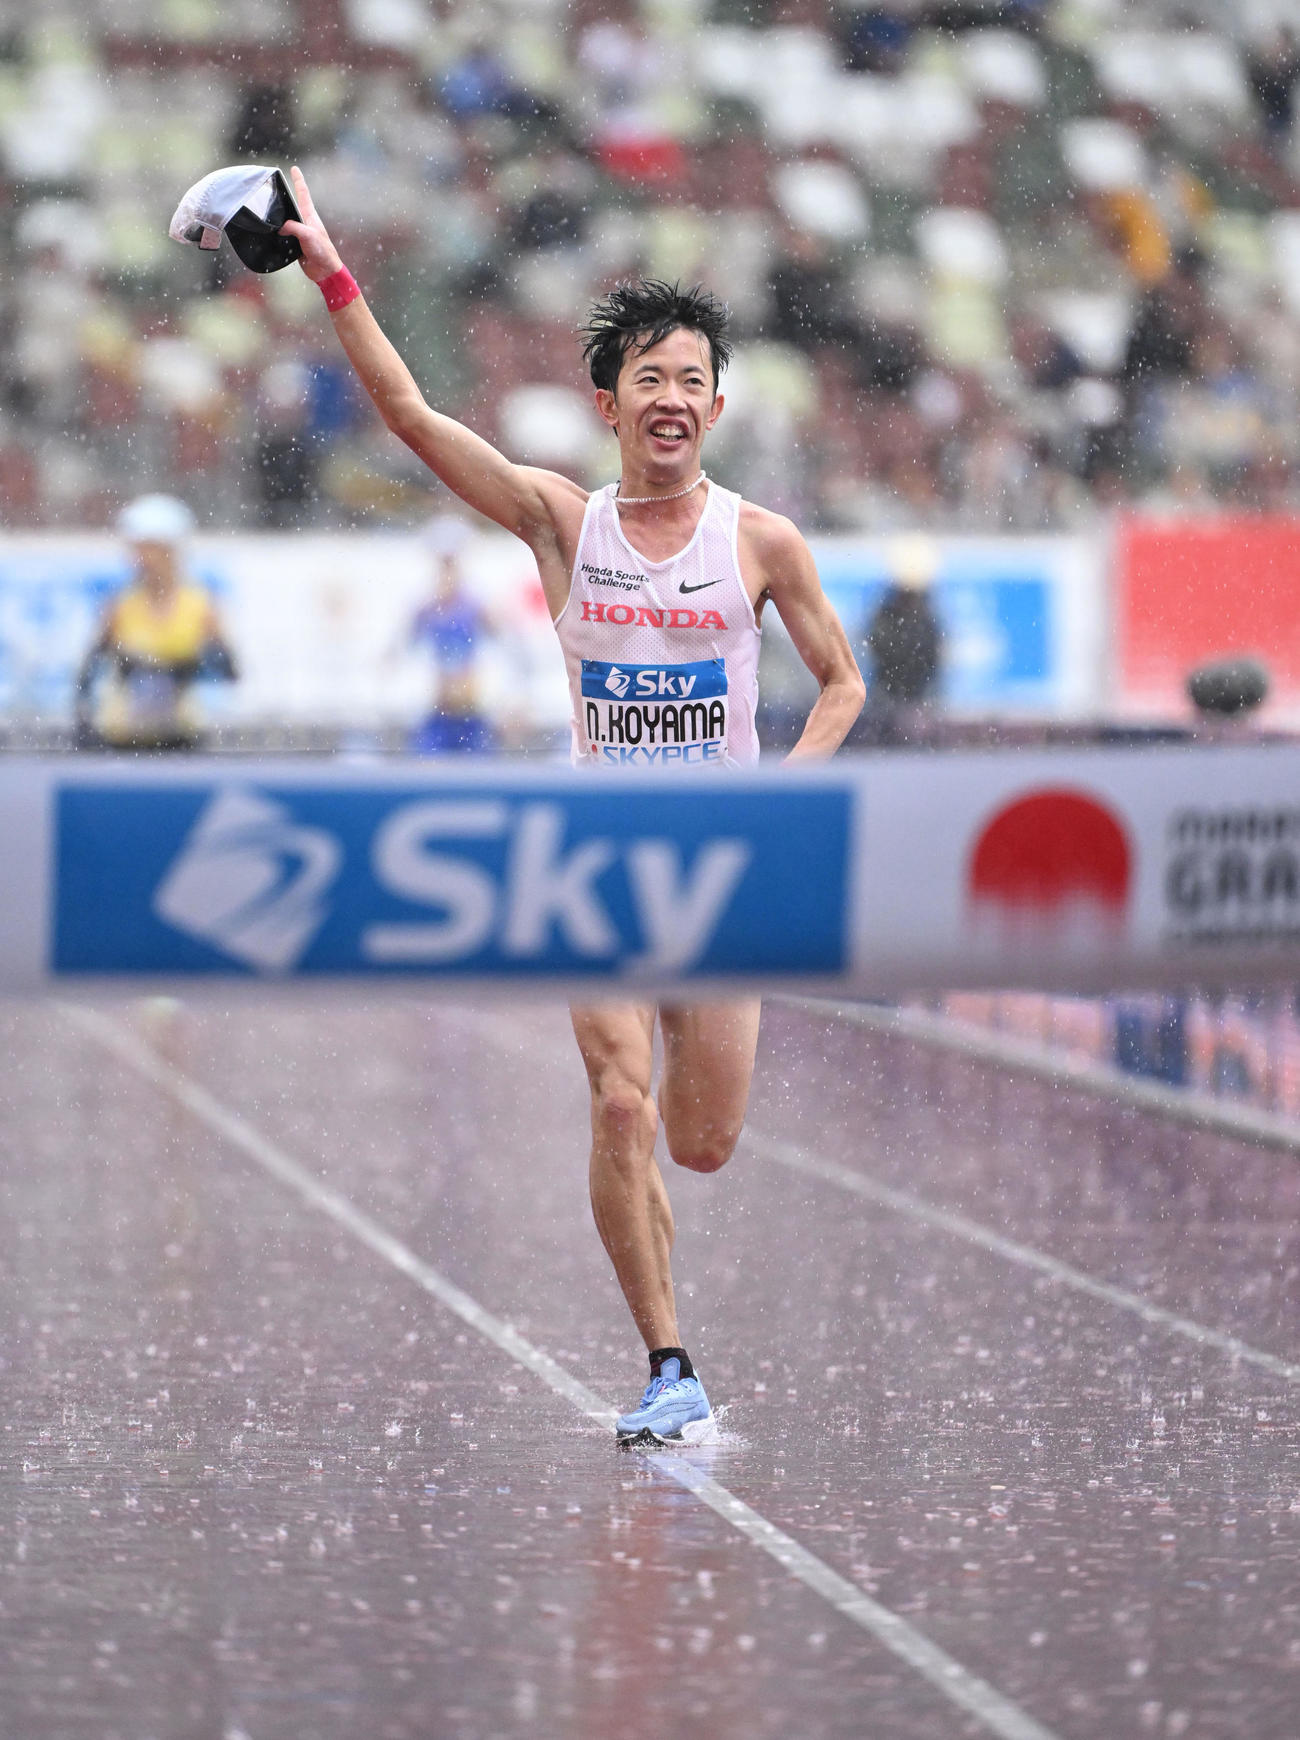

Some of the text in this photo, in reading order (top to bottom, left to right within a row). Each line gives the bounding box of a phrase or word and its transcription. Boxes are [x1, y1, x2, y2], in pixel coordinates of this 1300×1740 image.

[581, 563, 650, 583] Honda Sports
[588, 575, 641, 591] Challenge
[581, 601, 728, 630] HONDA
[635, 670, 696, 698] Sky
[586, 700, 725, 745] N.KOYAMA
[362, 797, 752, 976] Sky
